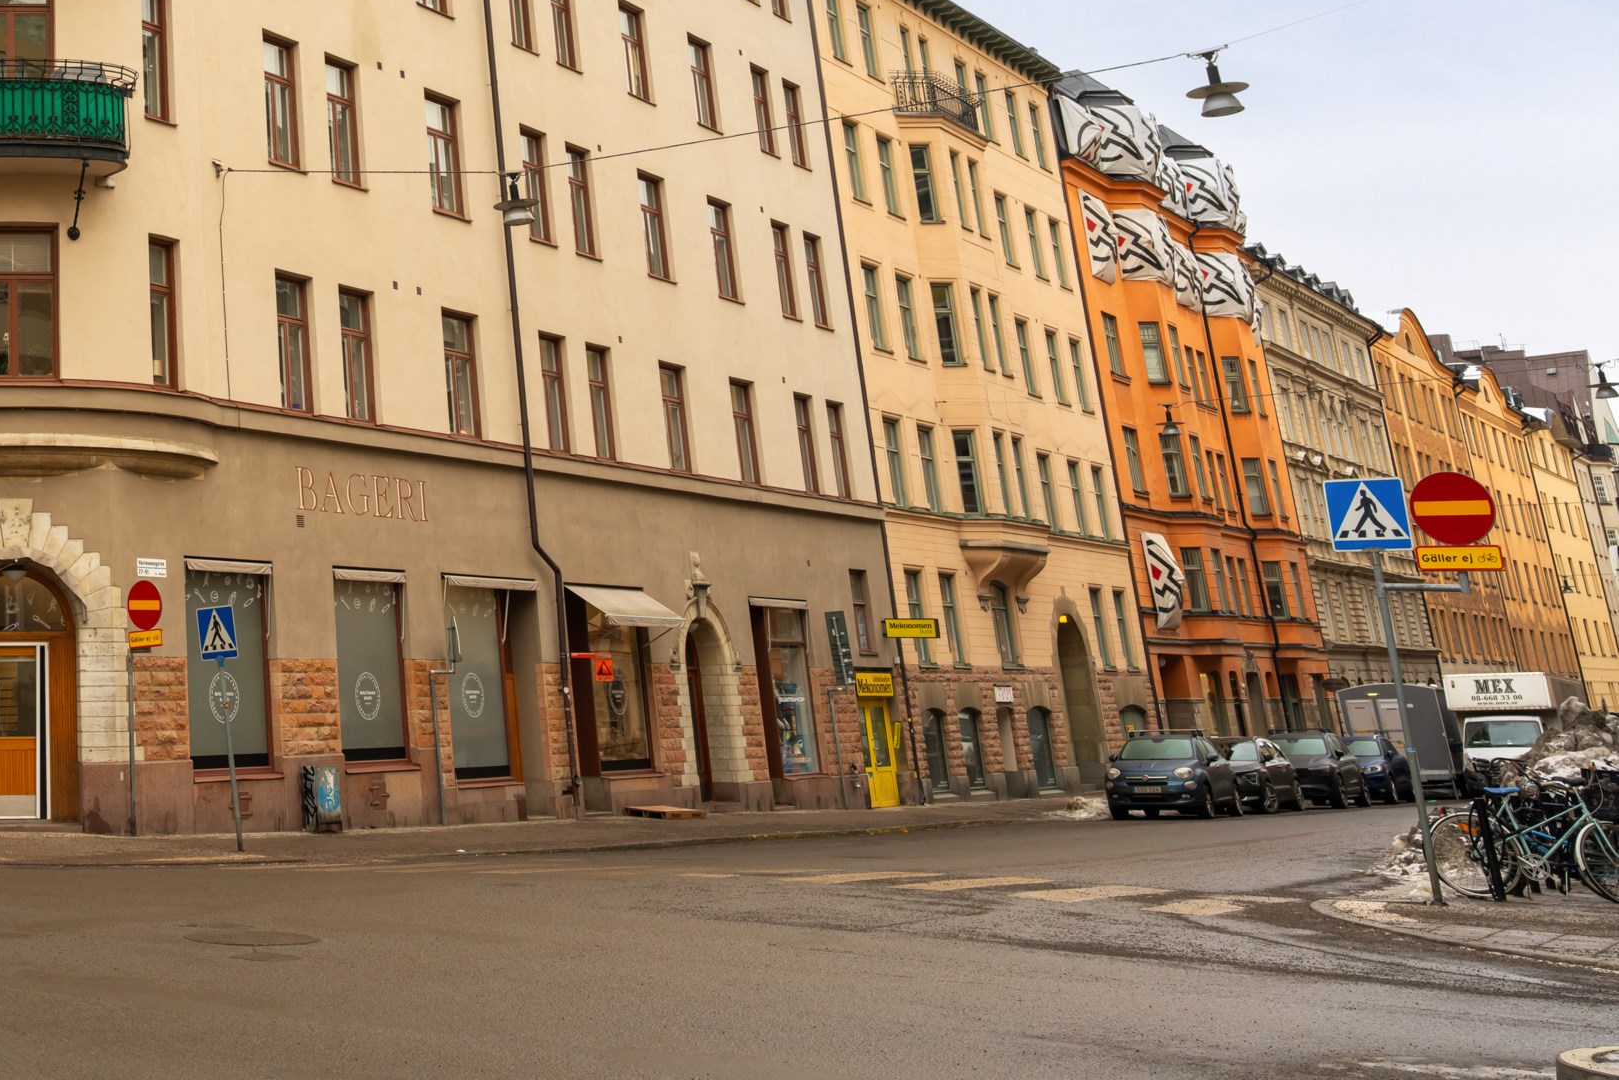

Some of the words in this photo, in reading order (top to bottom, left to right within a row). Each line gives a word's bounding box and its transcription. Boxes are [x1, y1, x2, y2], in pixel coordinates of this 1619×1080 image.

[295, 466, 428, 522] BAGERI
[1421, 553, 1458, 563] Gäller
[1461, 553, 1473, 565] ej
[888, 622, 933, 630] Mekonomen
[857, 677, 893, 694] Mekonomen
[1473, 678, 1517, 695] MEX
